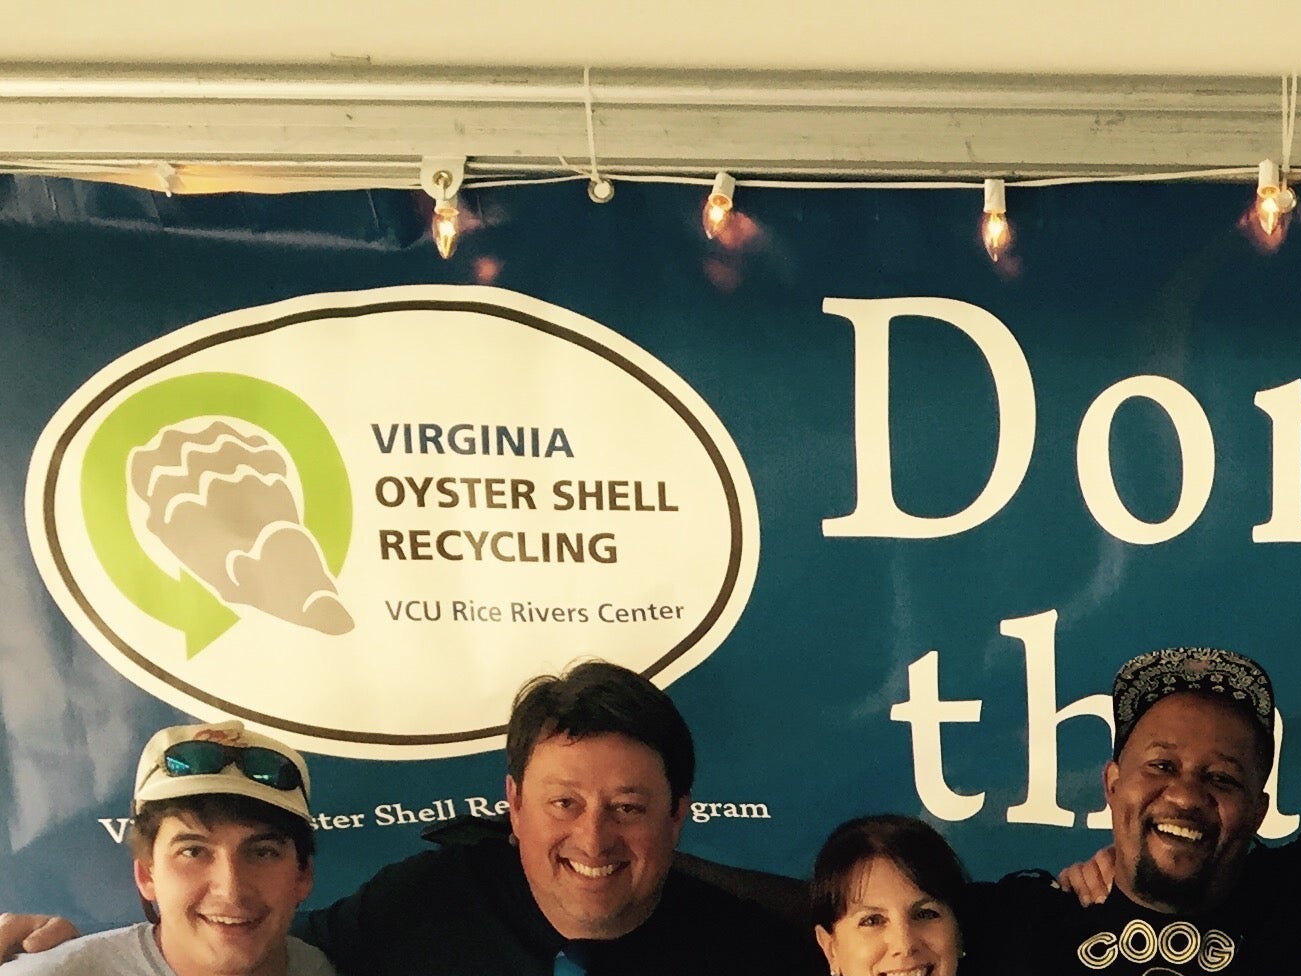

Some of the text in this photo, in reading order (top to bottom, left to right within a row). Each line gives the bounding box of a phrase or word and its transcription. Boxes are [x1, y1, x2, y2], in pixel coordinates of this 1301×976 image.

[371, 423, 575, 458] VIRGINIA
[375, 476, 679, 512] OYSTER SHELL
[379, 529, 618, 564] RECYCLING
[385, 599, 685, 623] VCU Rice Rivers Center
[311, 813, 365, 831] ster
[375, 799, 456, 826] Shell
[690, 802, 772, 823] gram
[1077, 919, 1235, 972] COOG
